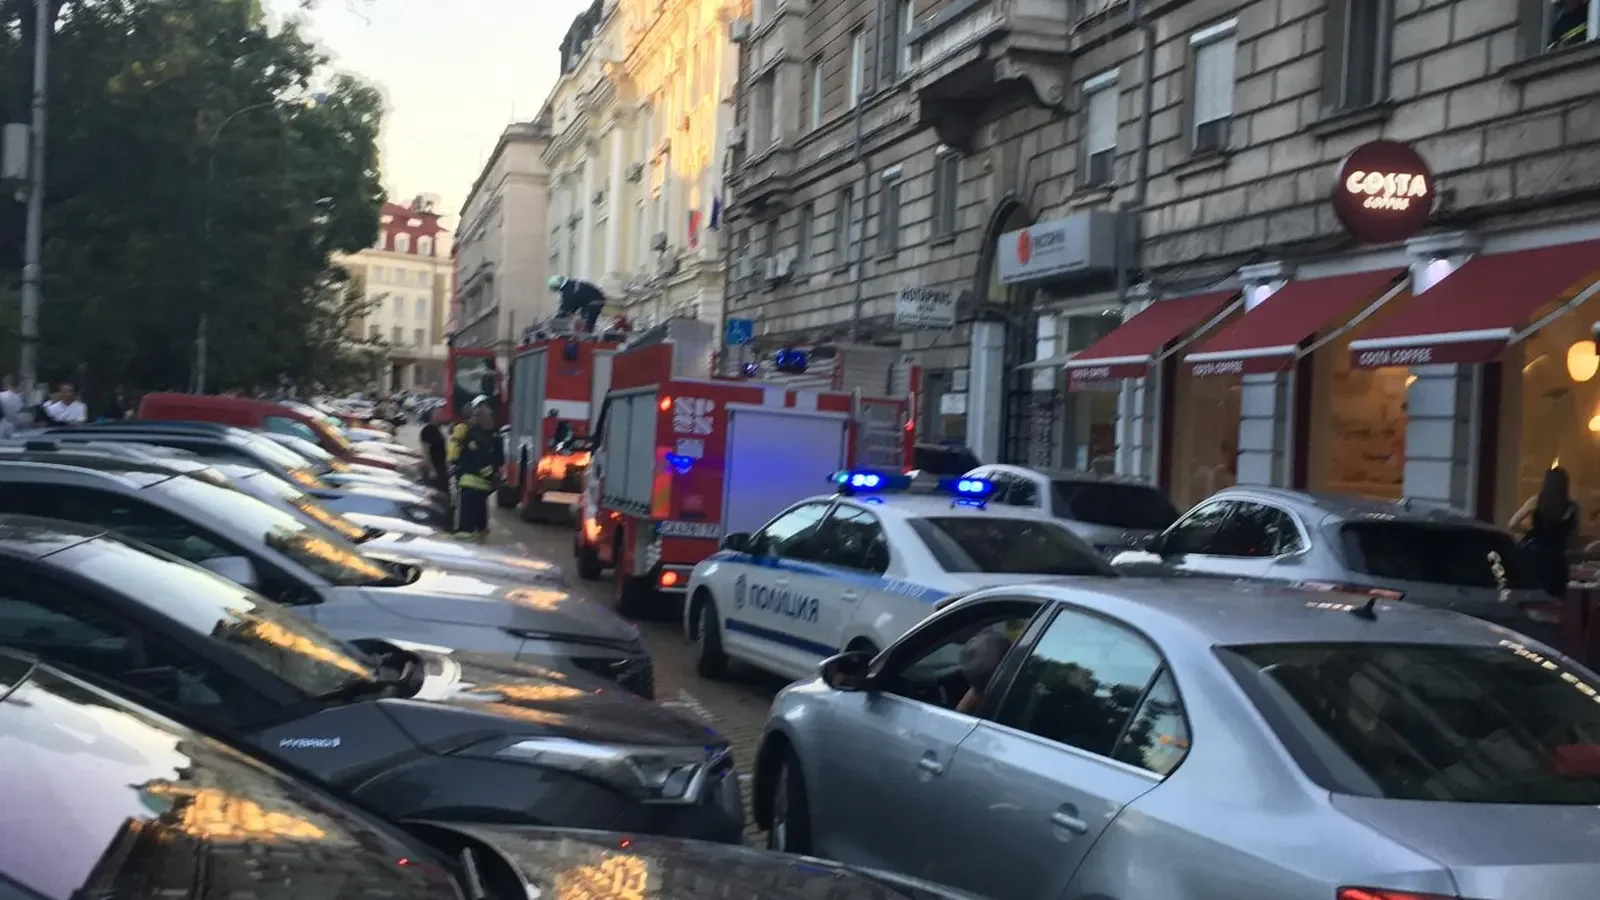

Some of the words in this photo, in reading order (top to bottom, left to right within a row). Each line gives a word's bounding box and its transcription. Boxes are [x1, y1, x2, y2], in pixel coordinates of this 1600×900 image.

[1346, 171, 1427, 197] COSTA
[1359, 350, 1391, 366] COSTA
[1391, 348, 1432, 364] COFFEE
[749, 583, 821, 624] ПОЛИЦИЯ
